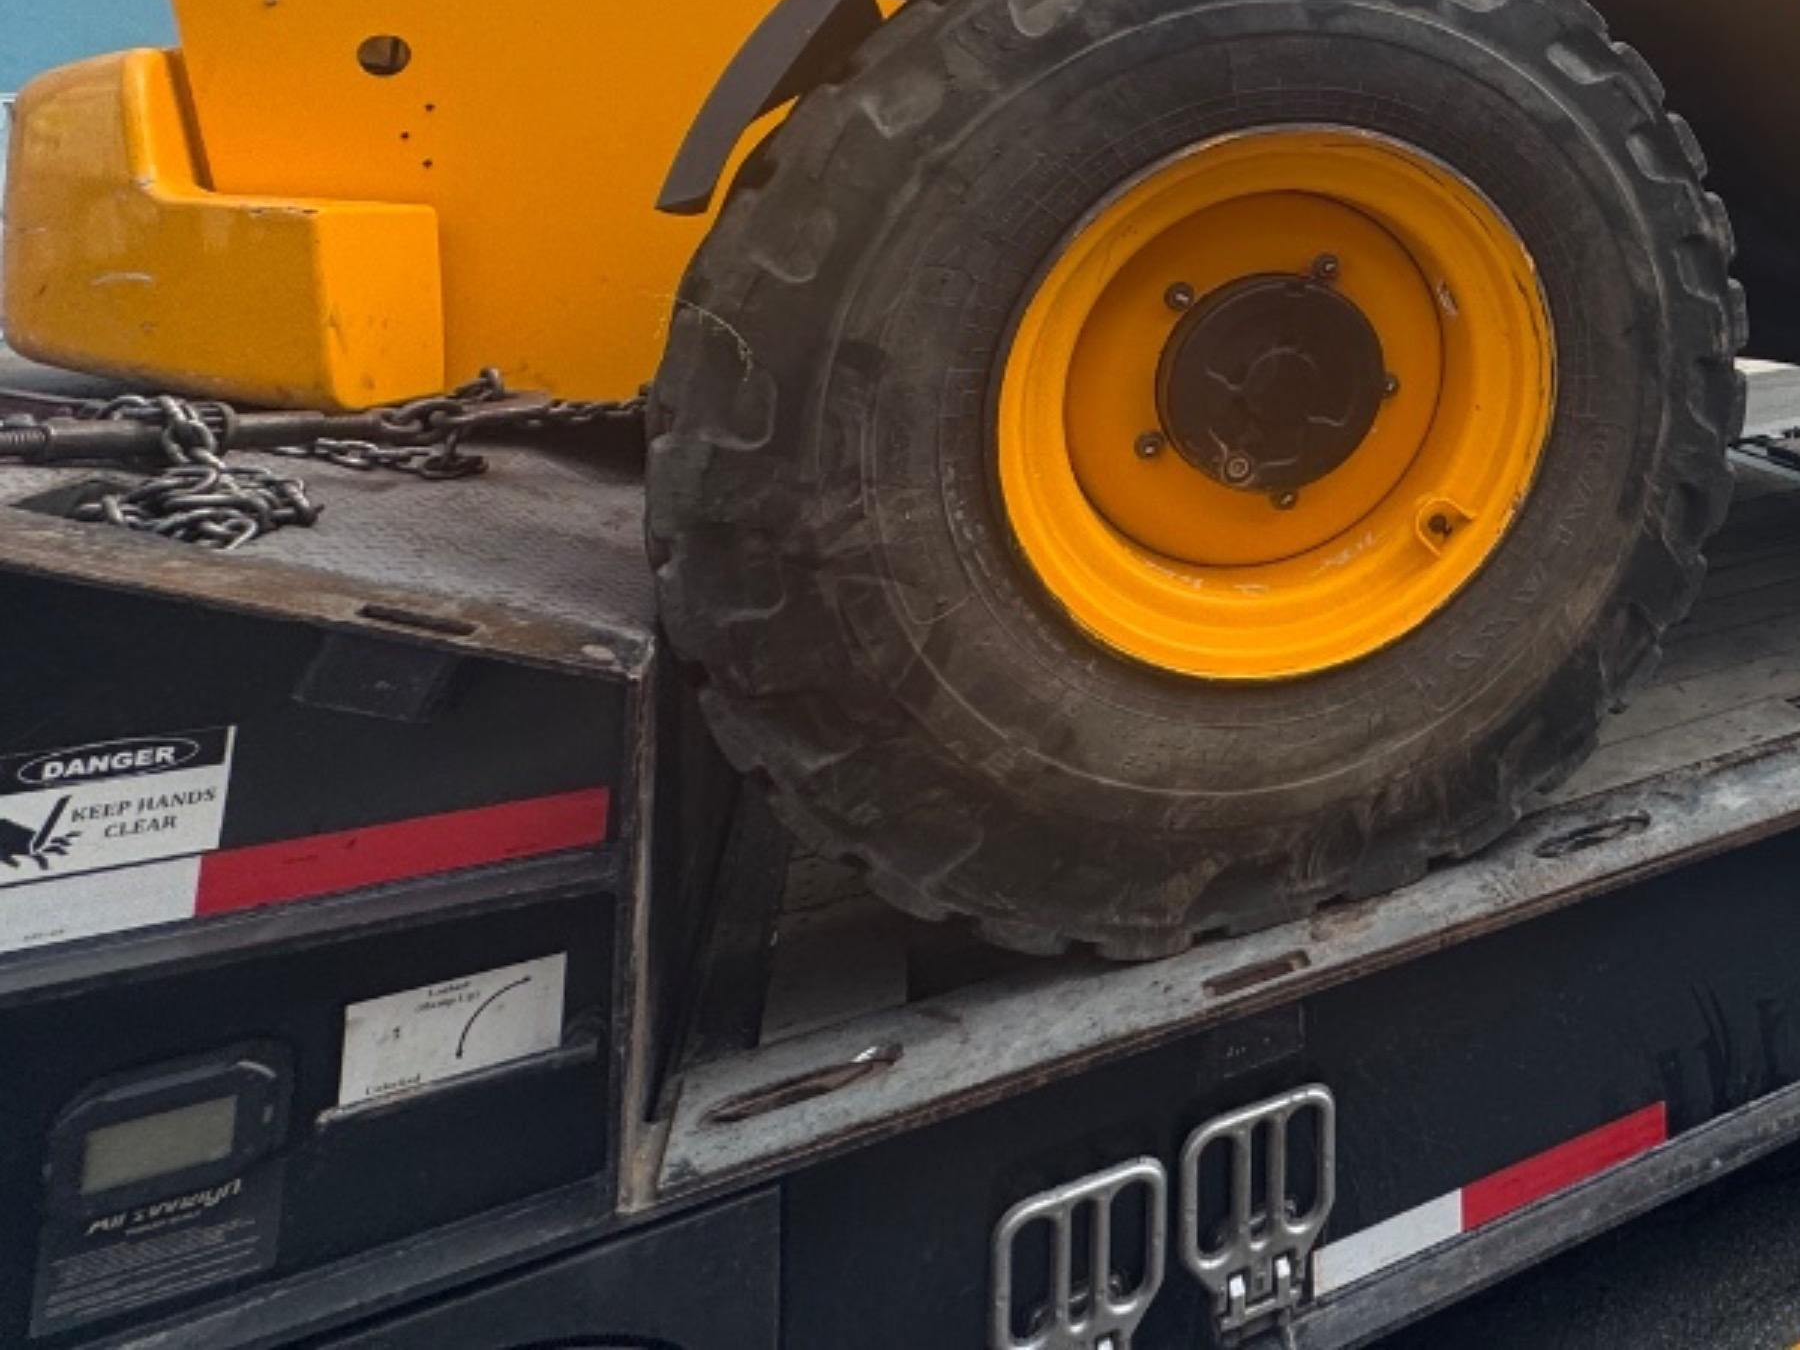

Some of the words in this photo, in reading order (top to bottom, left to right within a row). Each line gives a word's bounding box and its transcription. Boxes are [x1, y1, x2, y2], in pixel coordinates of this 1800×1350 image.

[41, 745, 176, 781] DANGER
[71, 800, 131, 823] KEEP
[137, 785, 218, 814] HANDS
[104, 814, 178, 838] CLEAR
